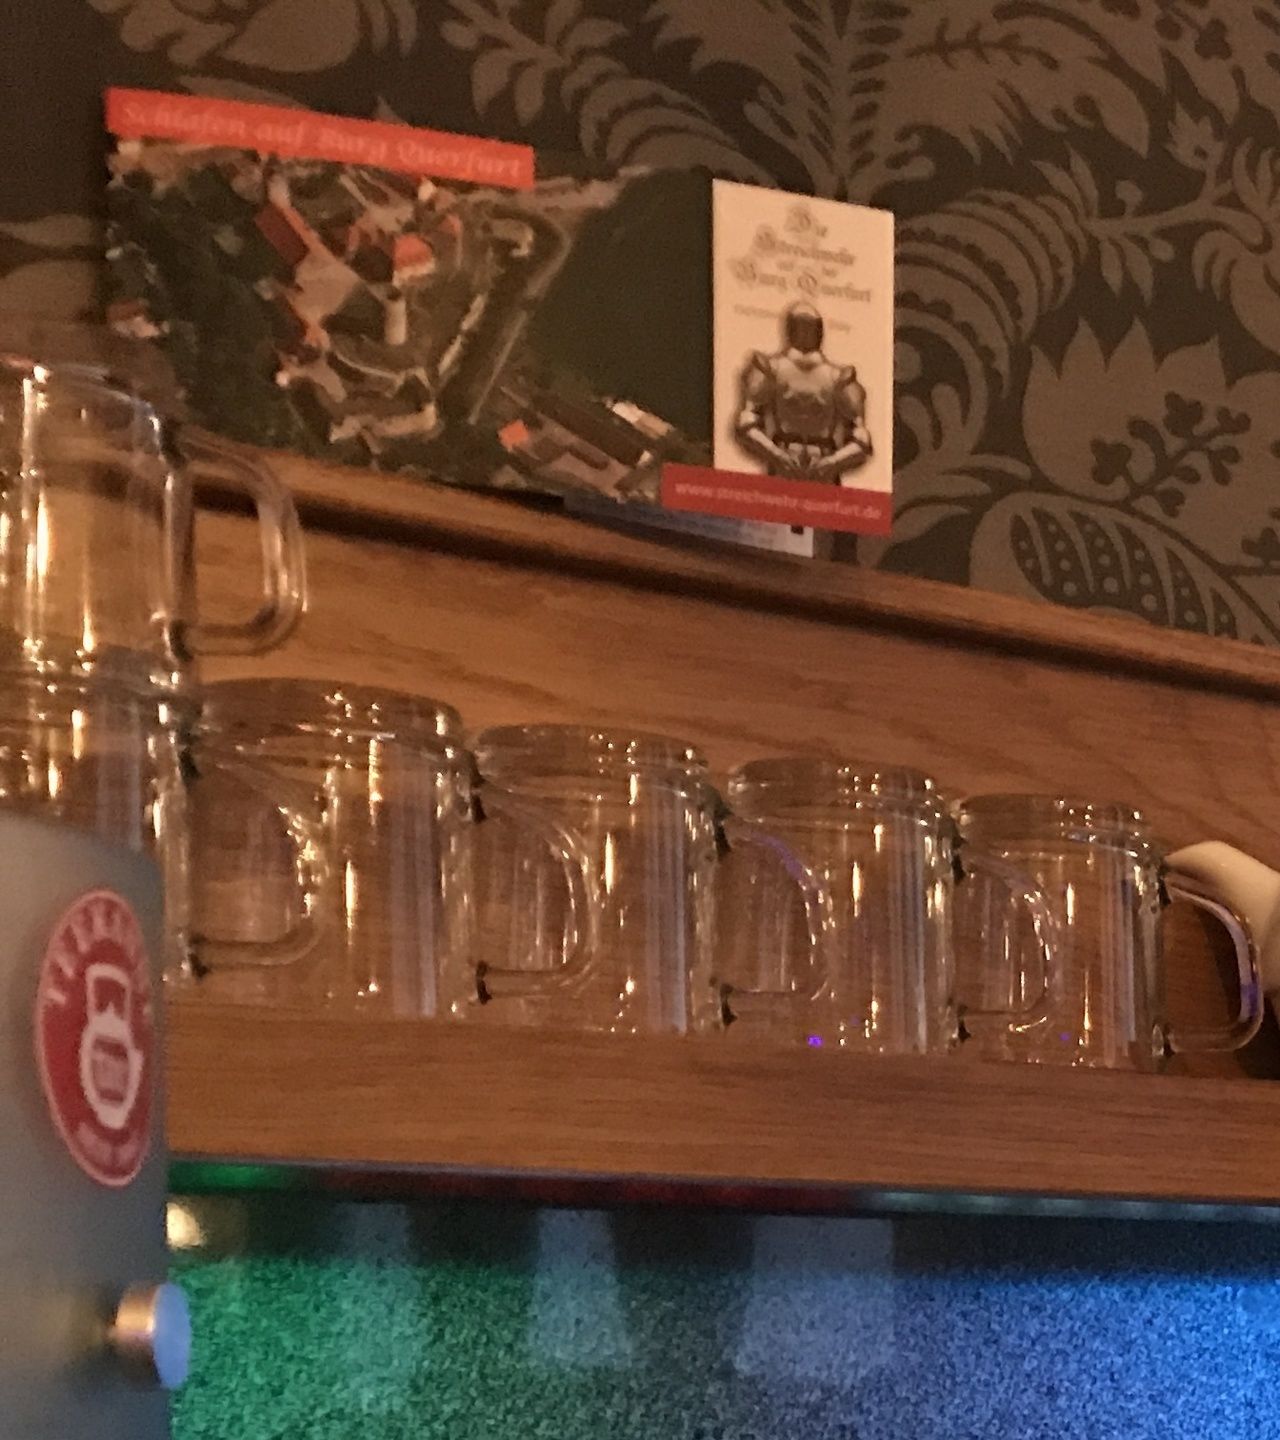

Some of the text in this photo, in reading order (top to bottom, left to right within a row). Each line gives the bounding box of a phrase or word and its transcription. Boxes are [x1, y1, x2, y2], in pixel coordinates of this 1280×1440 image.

[124, 104, 521, 180] Schlafen auf Burg Querfurt
